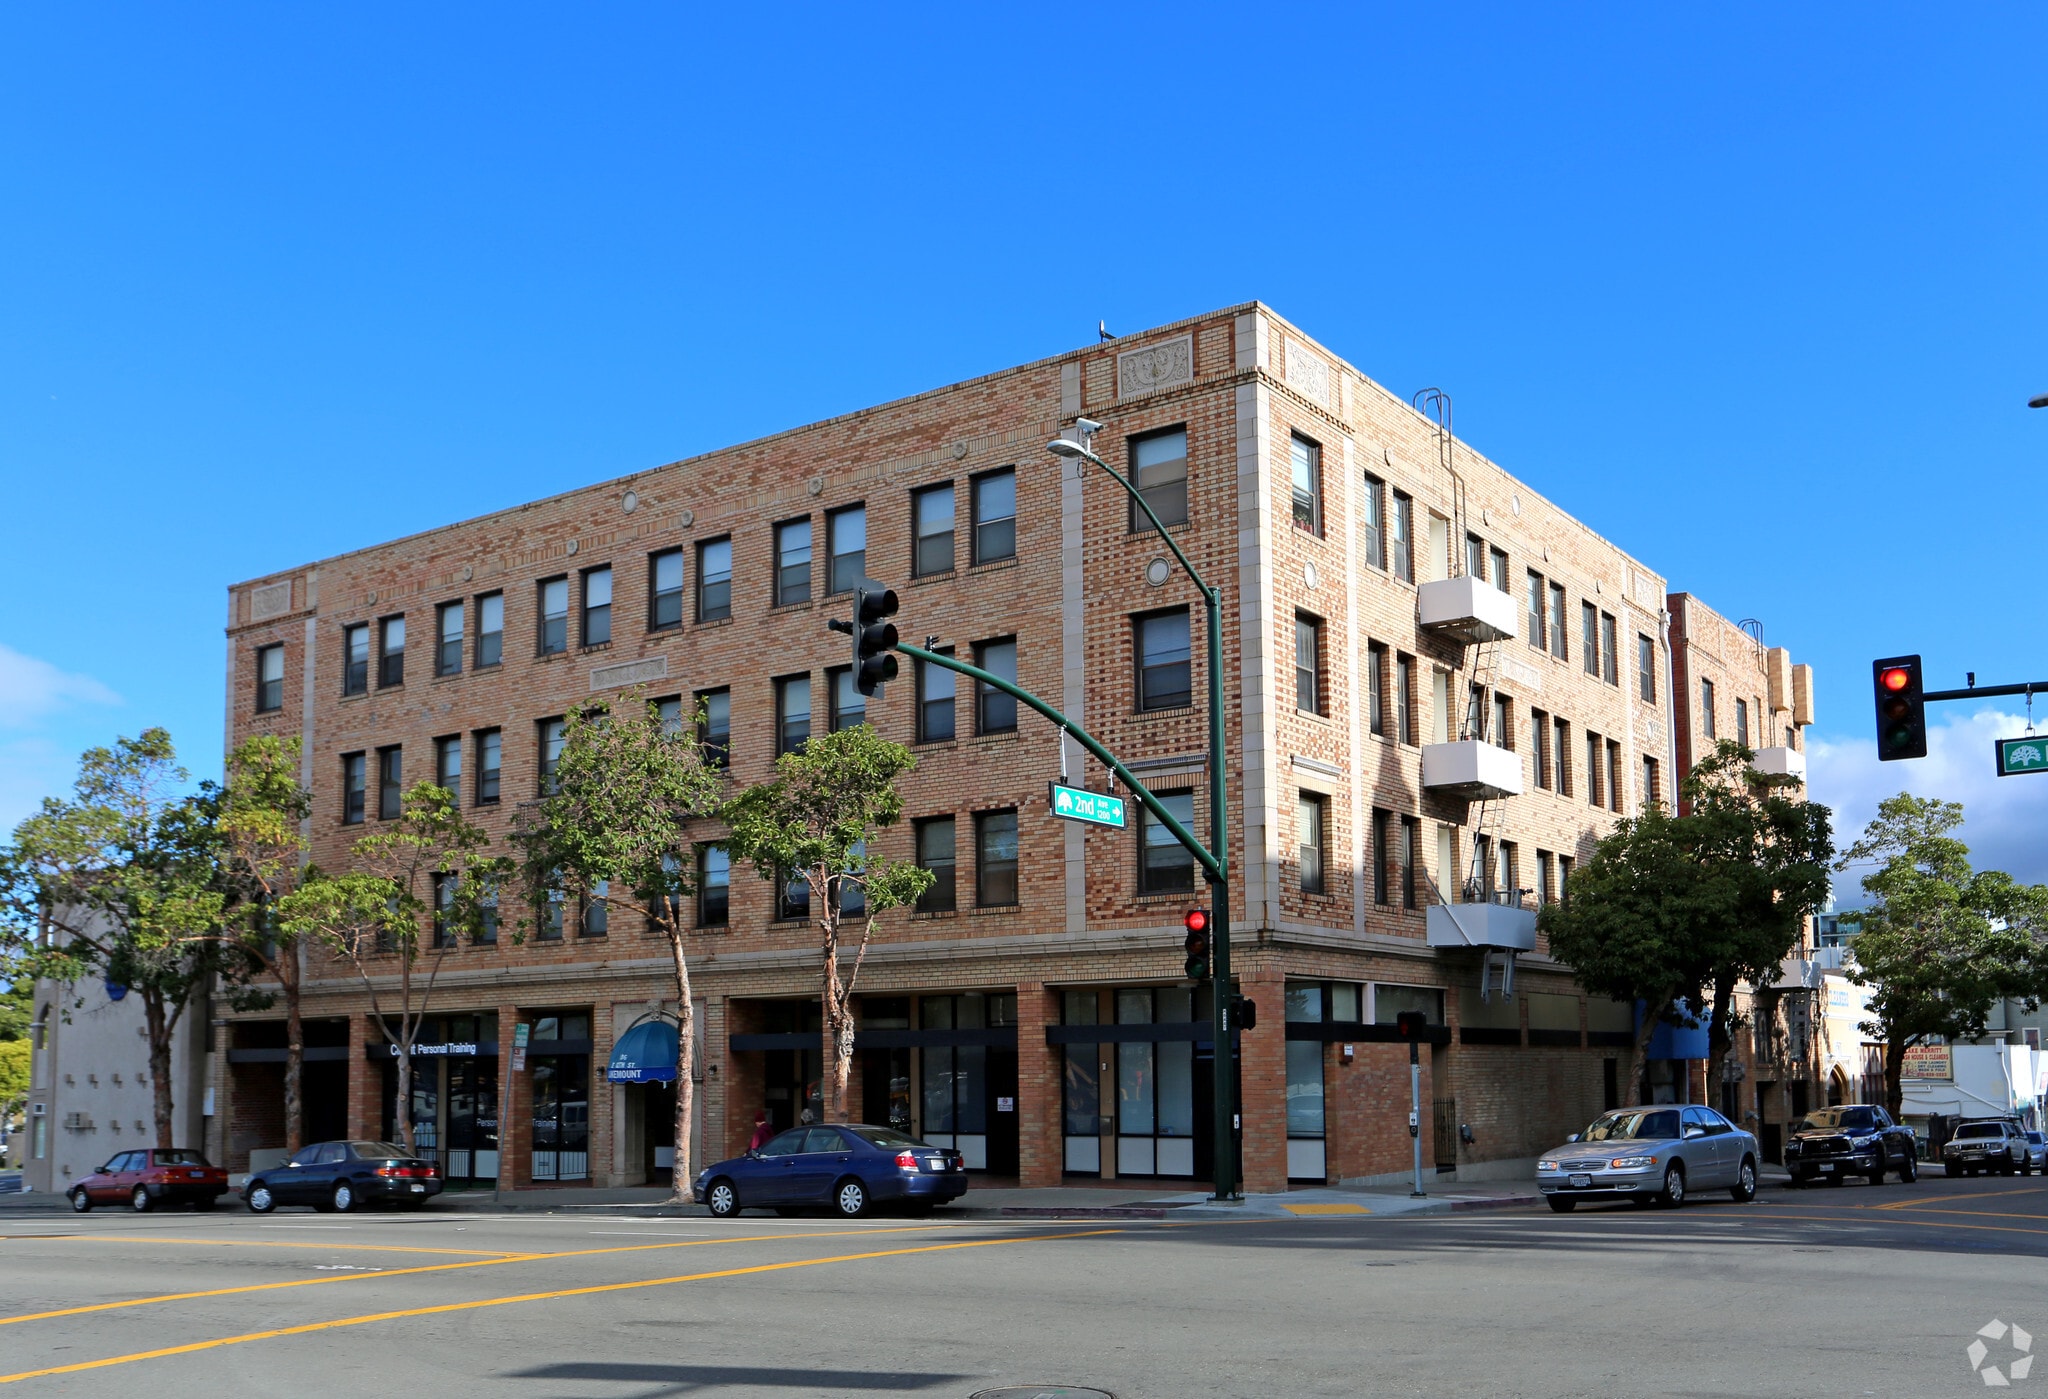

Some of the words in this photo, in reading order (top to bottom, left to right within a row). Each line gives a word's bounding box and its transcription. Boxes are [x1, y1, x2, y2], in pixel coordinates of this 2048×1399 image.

[1075, 795, 1095, 816] 2nd
[1097, 799, 1109, 809] Ave
[1097, 810, 1111, 820] 1200
[418, 1043, 448, 1055] Personal
[448, 1042, 476, 1055] Training
[476, 1118, 498, 1127] Person
